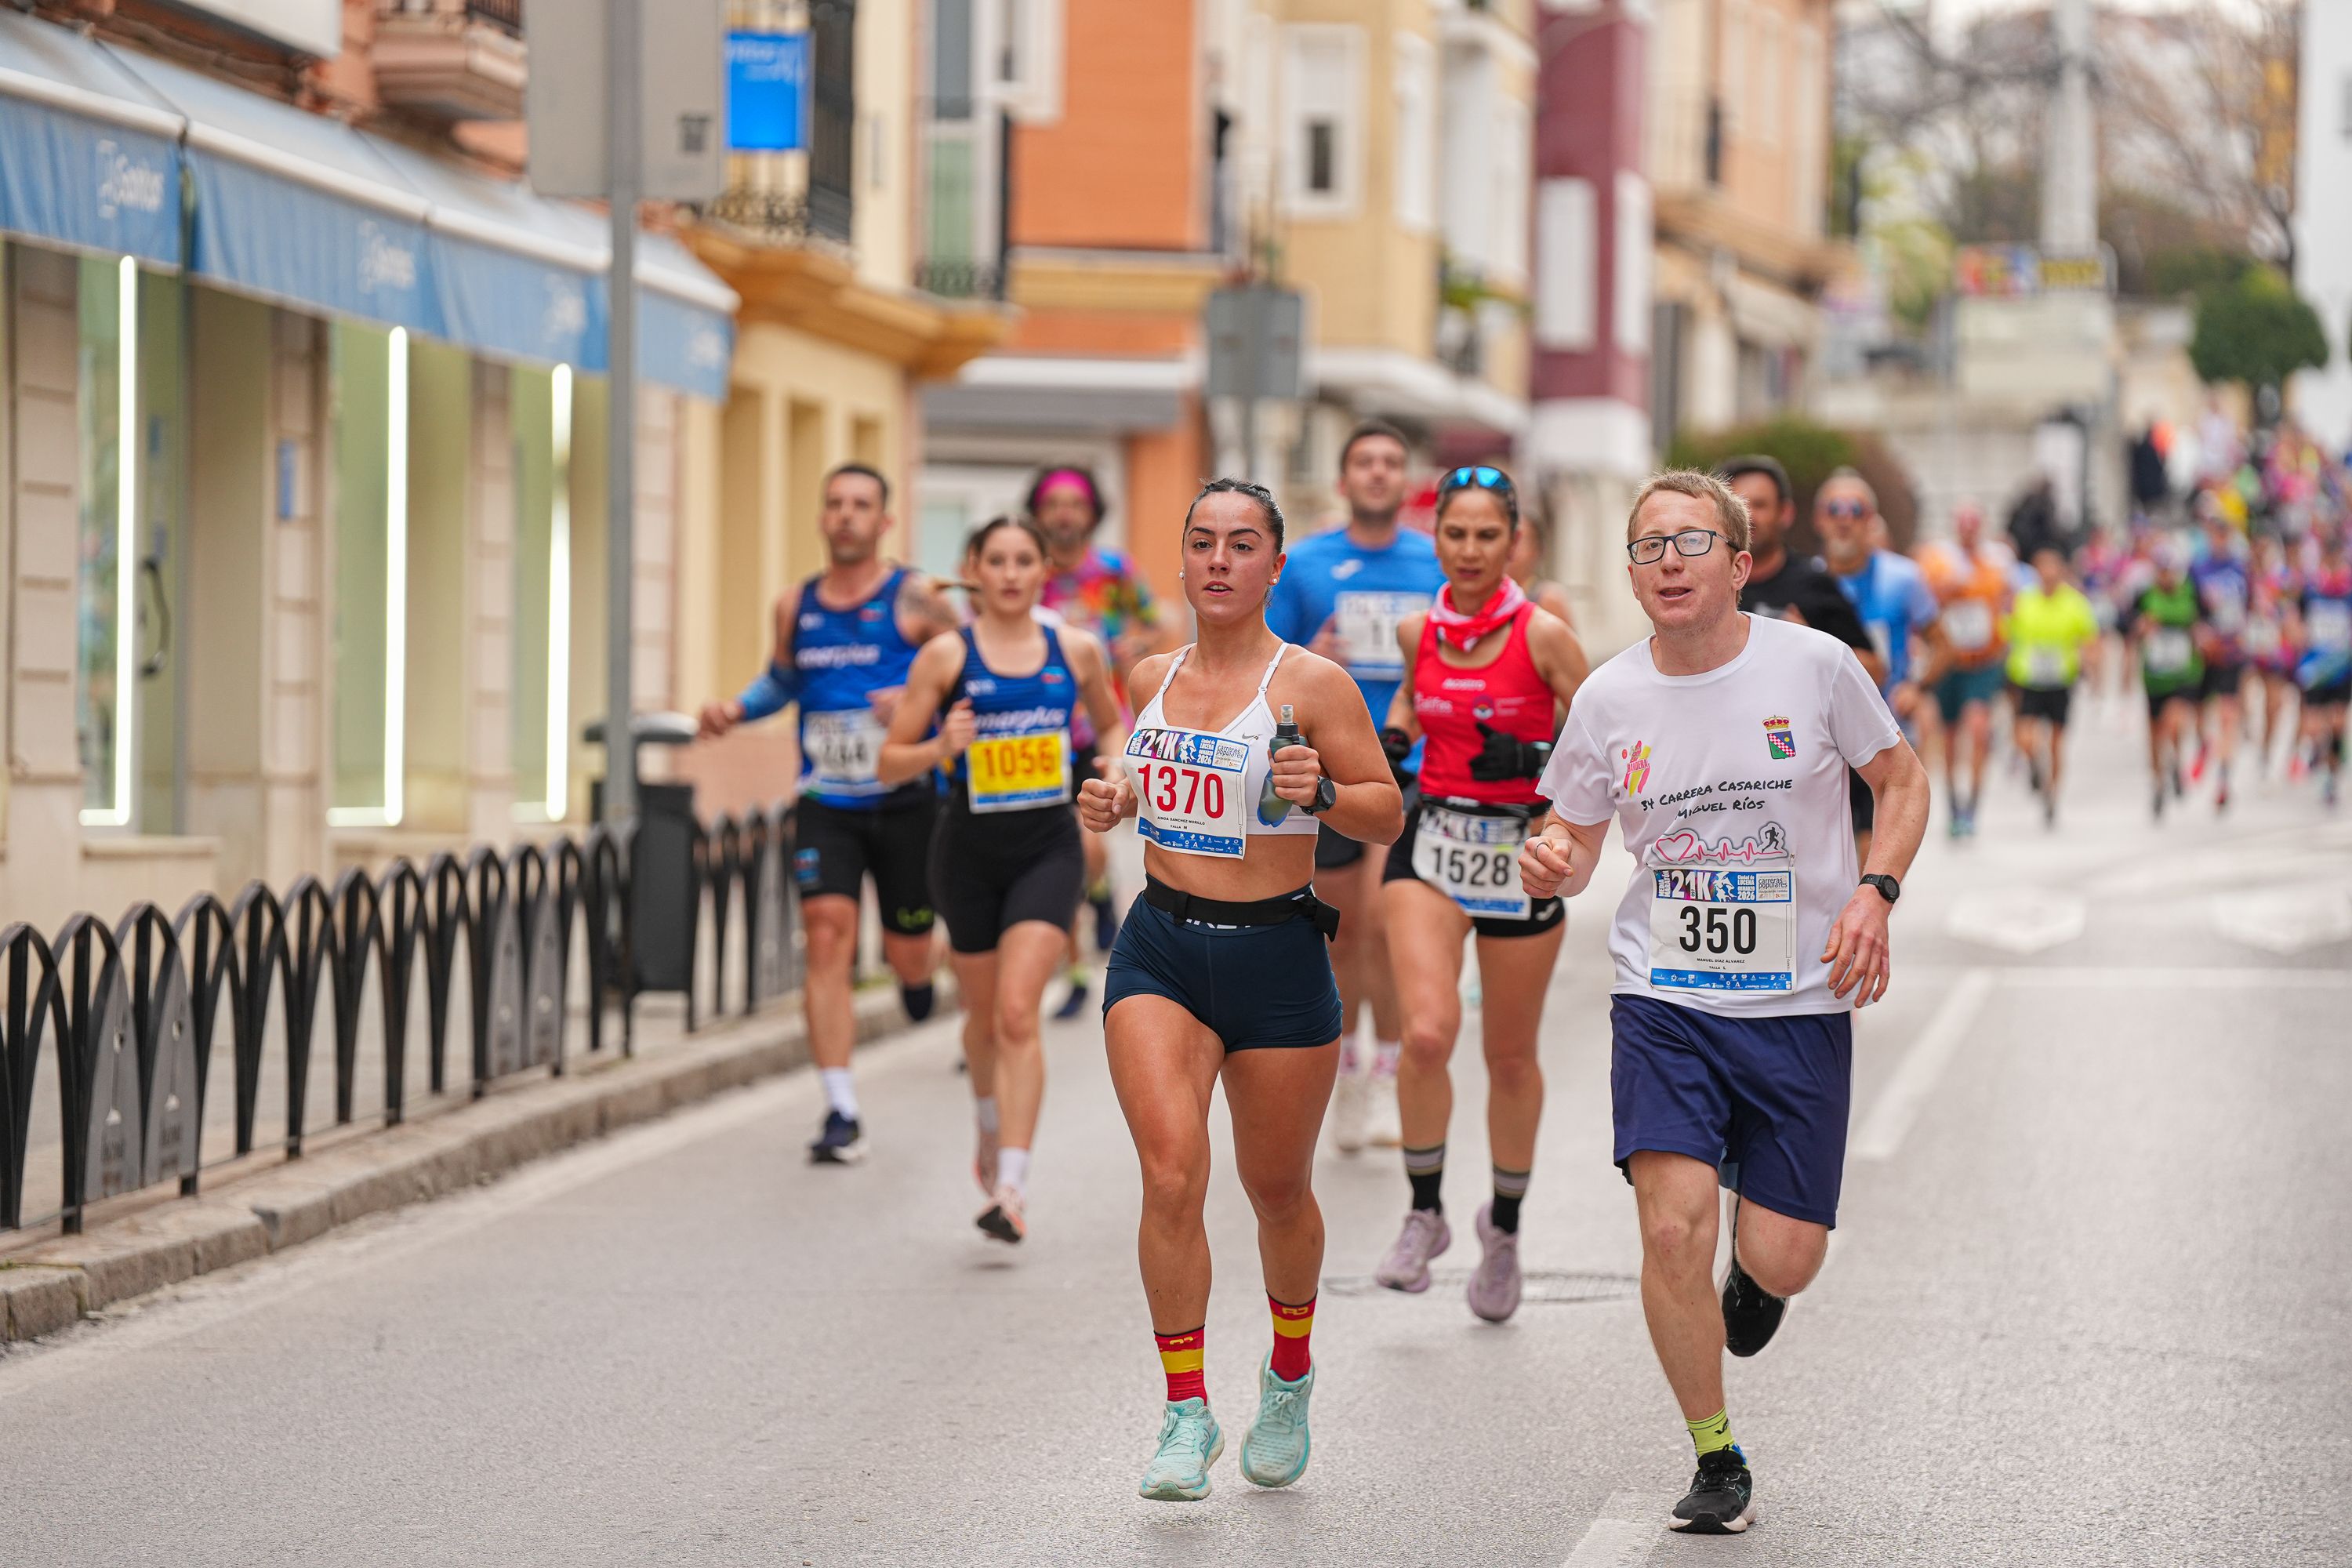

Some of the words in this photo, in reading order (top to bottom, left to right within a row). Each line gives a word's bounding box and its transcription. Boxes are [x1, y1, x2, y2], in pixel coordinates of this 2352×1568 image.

[983, 738, 1056, 779] 1056
[1140, 730, 1181, 760] 21K
[1216, 750, 1244, 760] populares
[1218, 746, 1241, 754] carreras
[1196, 754, 1212, 765] 2026
[1138, 763, 1225, 819] 1370
[1659, 785, 1713, 806] CARRERA
[1718, 779, 1793, 792] CASARICHE
[1675, 801, 1727, 821] MIGUEL
[1732, 797, 1766, 811] RÍOS
[1432, 846, 1511, 887] 1528
[1671, 869, 1711, 900] 21K
[1737, 891, 1755, 901] 2026
[1759, 881, 1788, 890] populares
[1679, 906, 1756, 955] 350
